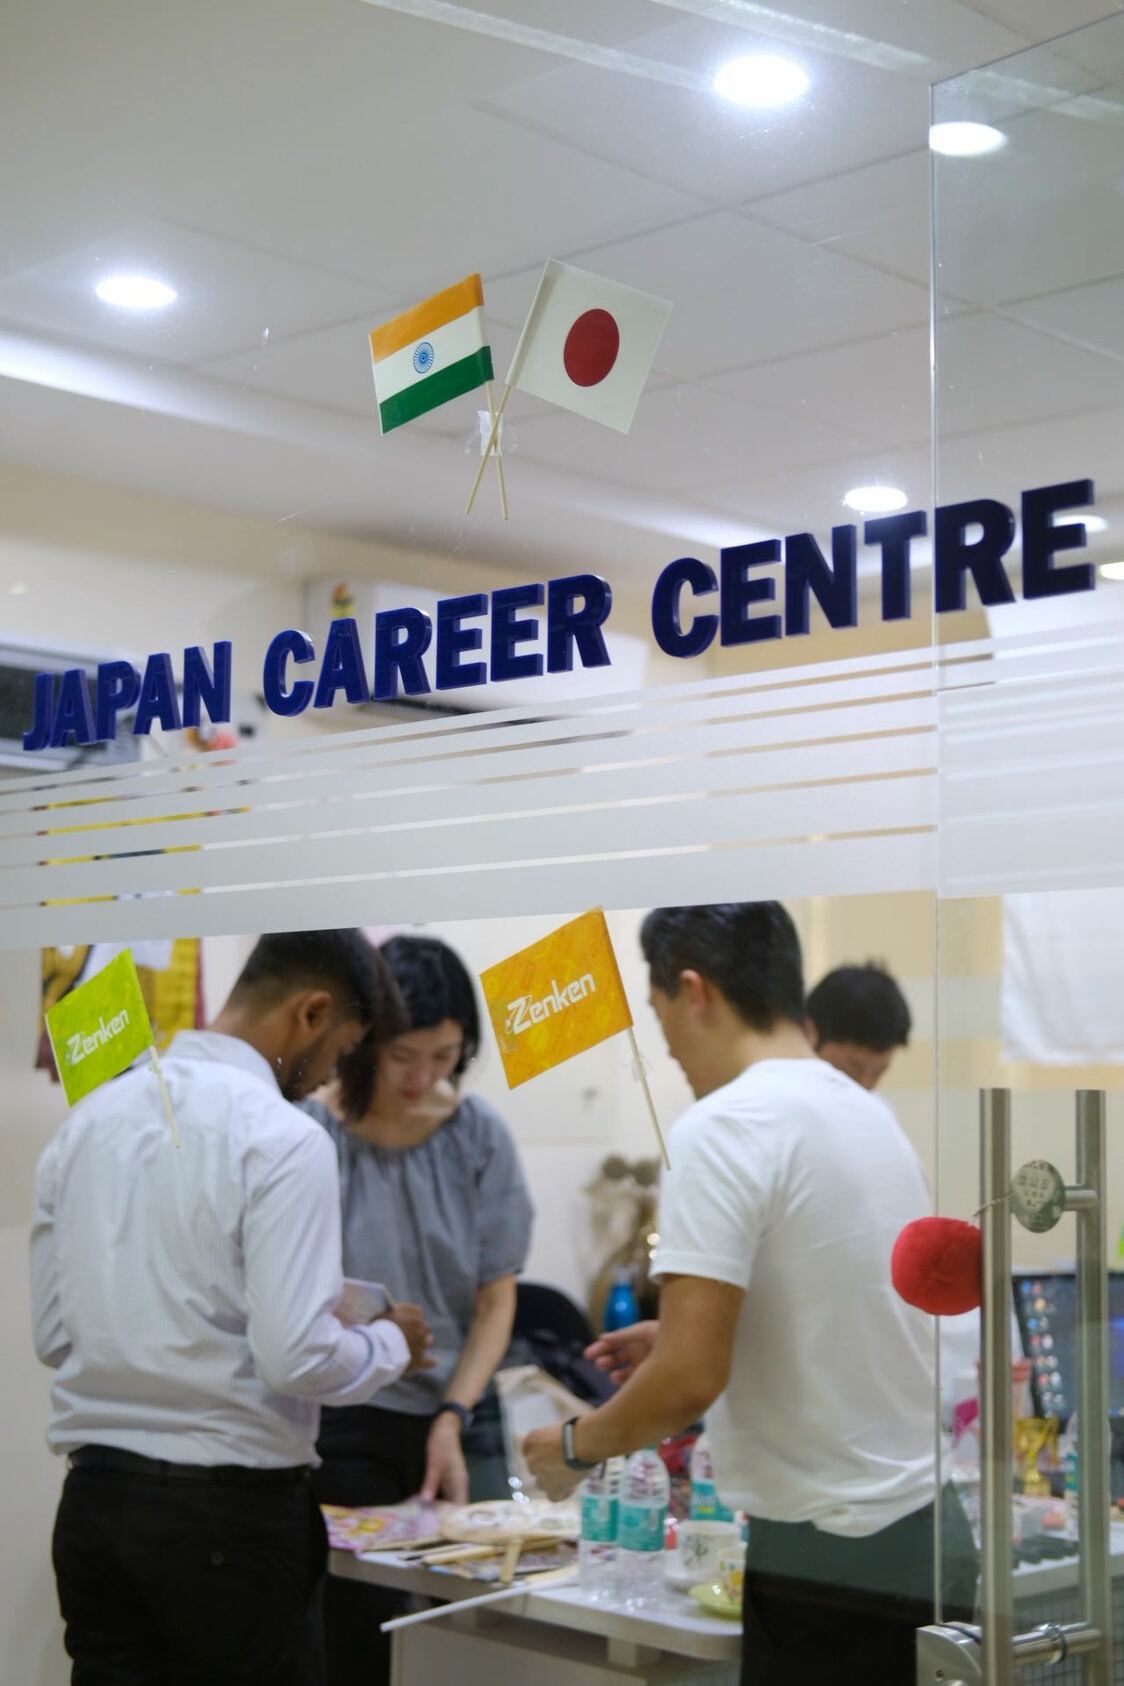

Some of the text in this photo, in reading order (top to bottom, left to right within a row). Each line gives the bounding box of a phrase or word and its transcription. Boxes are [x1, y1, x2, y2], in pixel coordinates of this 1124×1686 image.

[23, 478, 1096, 751] JAPAN CAREER CENTRE
[506, 973, 596, 1034] Zenken
[66, 1009, 130, 1066] Zenken
